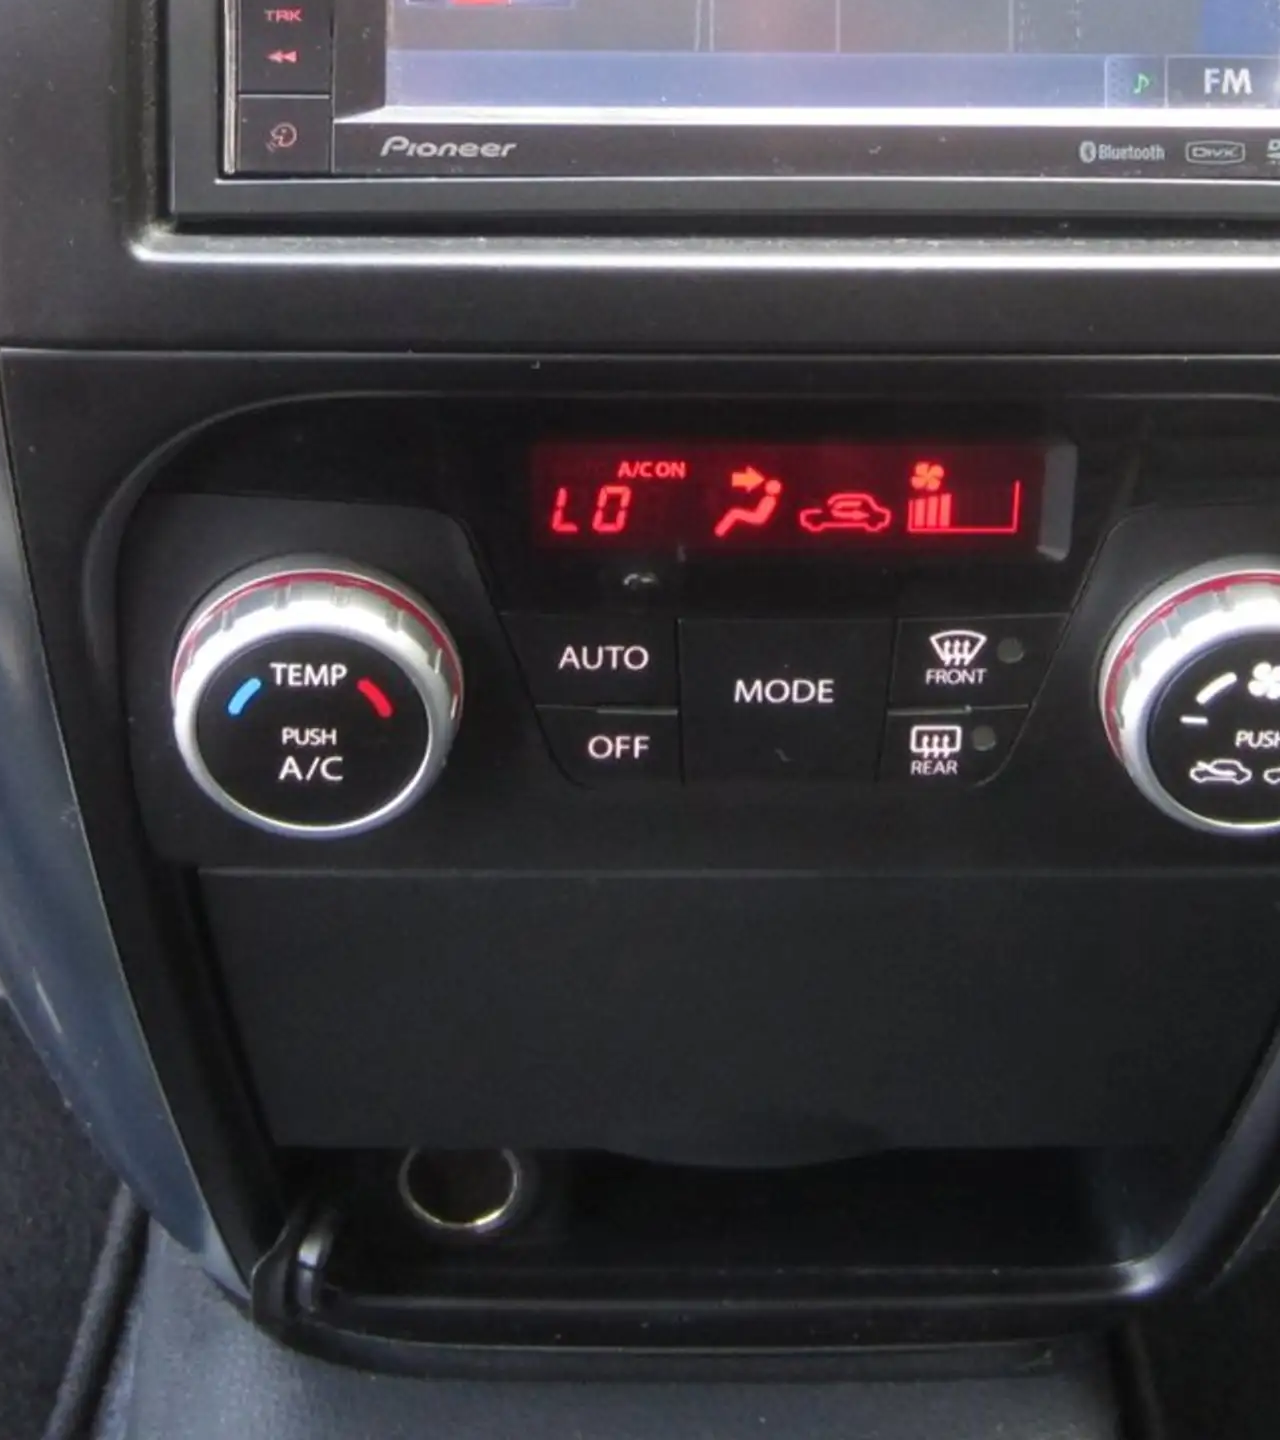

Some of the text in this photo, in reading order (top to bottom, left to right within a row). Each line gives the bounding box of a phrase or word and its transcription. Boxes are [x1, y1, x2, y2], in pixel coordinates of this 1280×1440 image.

[264, 9, 303, 22] TRK
[1203, 68, 1253, 96] FM
[380, 136, 517, 158] Pioneer
[1098, 143, 1166, 161] Bluetooth
[618, 461, 687, 480] A/C ON
[558, 646, 650, 671] AUTO
[270, 662, 348, 687] TEMP
[925, 668, 987, 685] FRONT
[733, 679, 836, 705] MODE
[281, 727, 337, 746] PUSH
[587, 735, 651, 760] OFF
[278, 755, 344, 781] A/C
[910, 760, 959, 776] REAR
